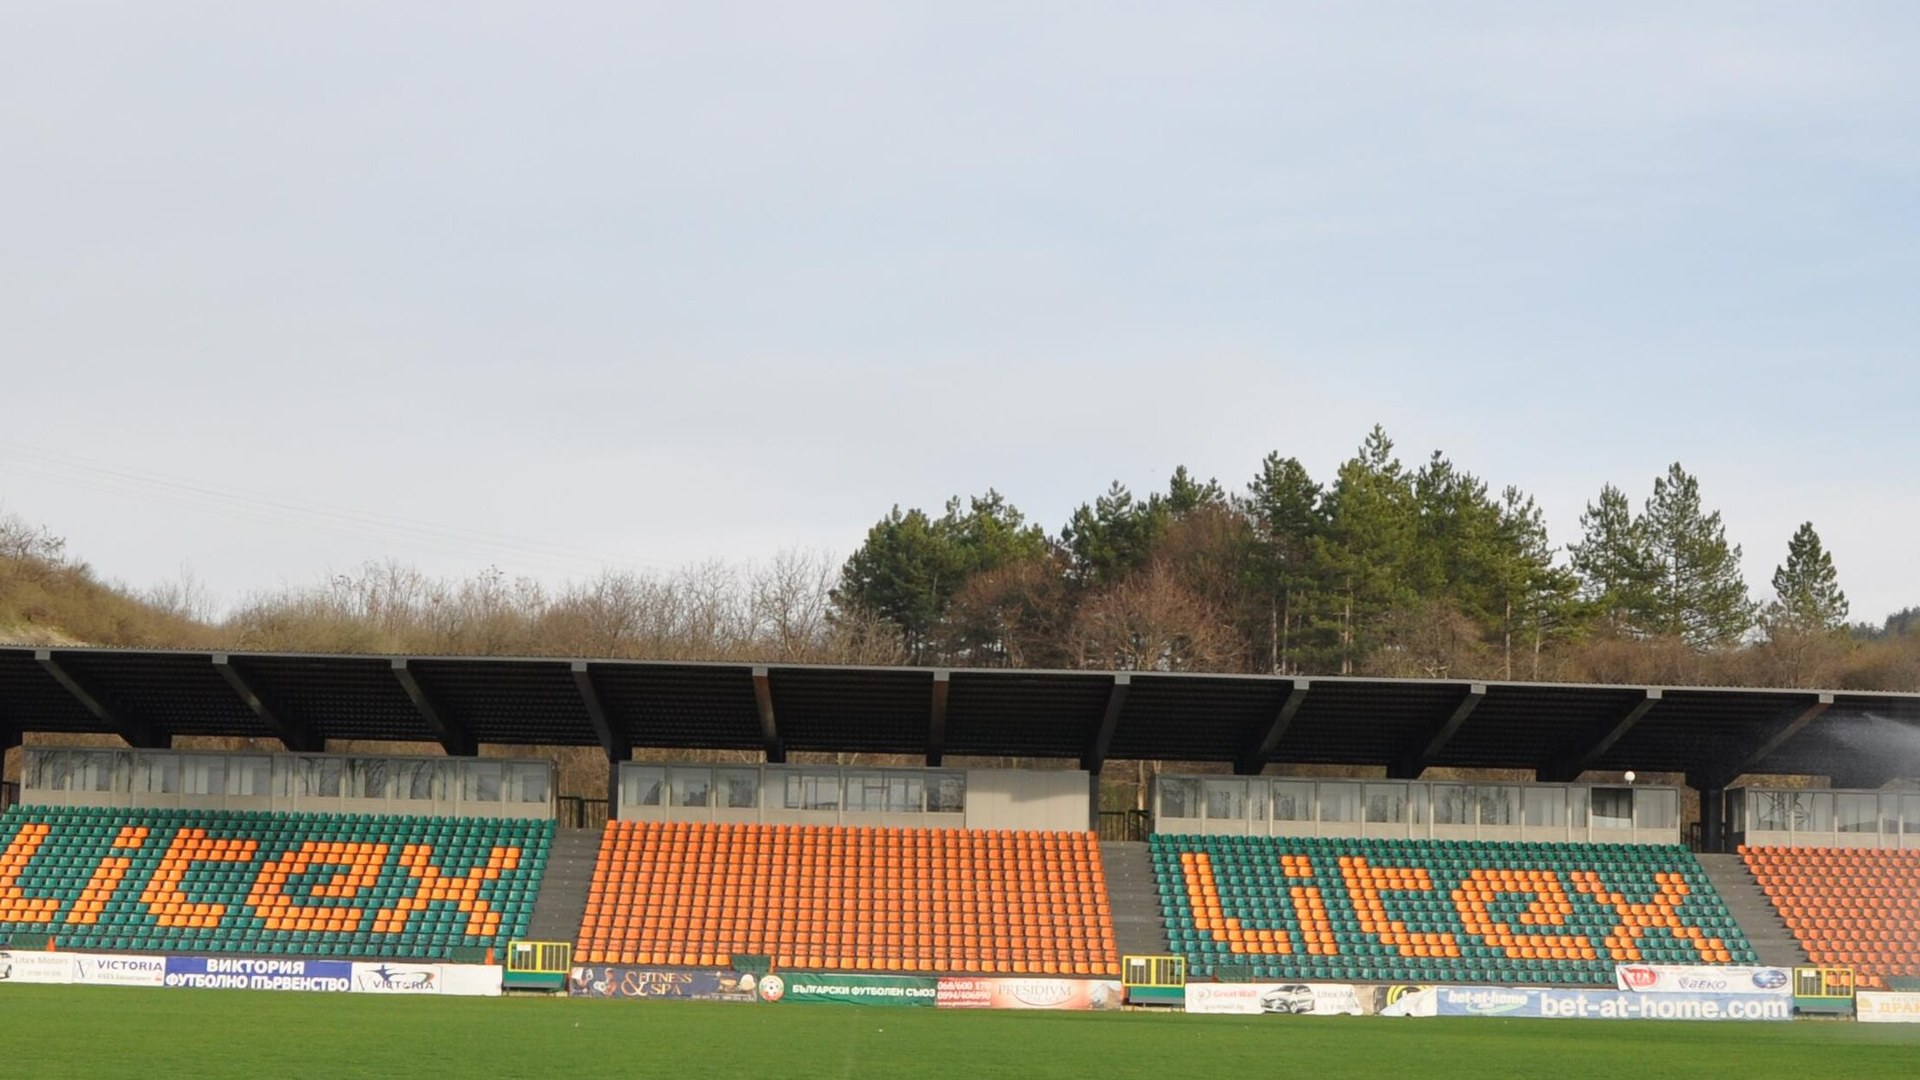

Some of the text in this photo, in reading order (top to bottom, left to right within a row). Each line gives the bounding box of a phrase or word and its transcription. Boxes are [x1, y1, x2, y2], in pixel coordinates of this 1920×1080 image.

[97, 959, 164, 972] VICTORIA
[206, 958, 305, 975] ВИКТОРИЯ
[165, 973, 248, 989] ФУТБОЛНО
[250, 975, 350, 992] ПЪРВЕНСТВО
[373, 980, 434, 990] VICTORIA
[650, 983, 683, 995] SPA
[792, 984, 936, 998] БЪЛГАРСКИ ФУТБОЛЕН СЪЮЗ
[1448, 989, 1529, 1005] bet-at-home
[1540, 993, 1789, 1020] bet-at-home.com
